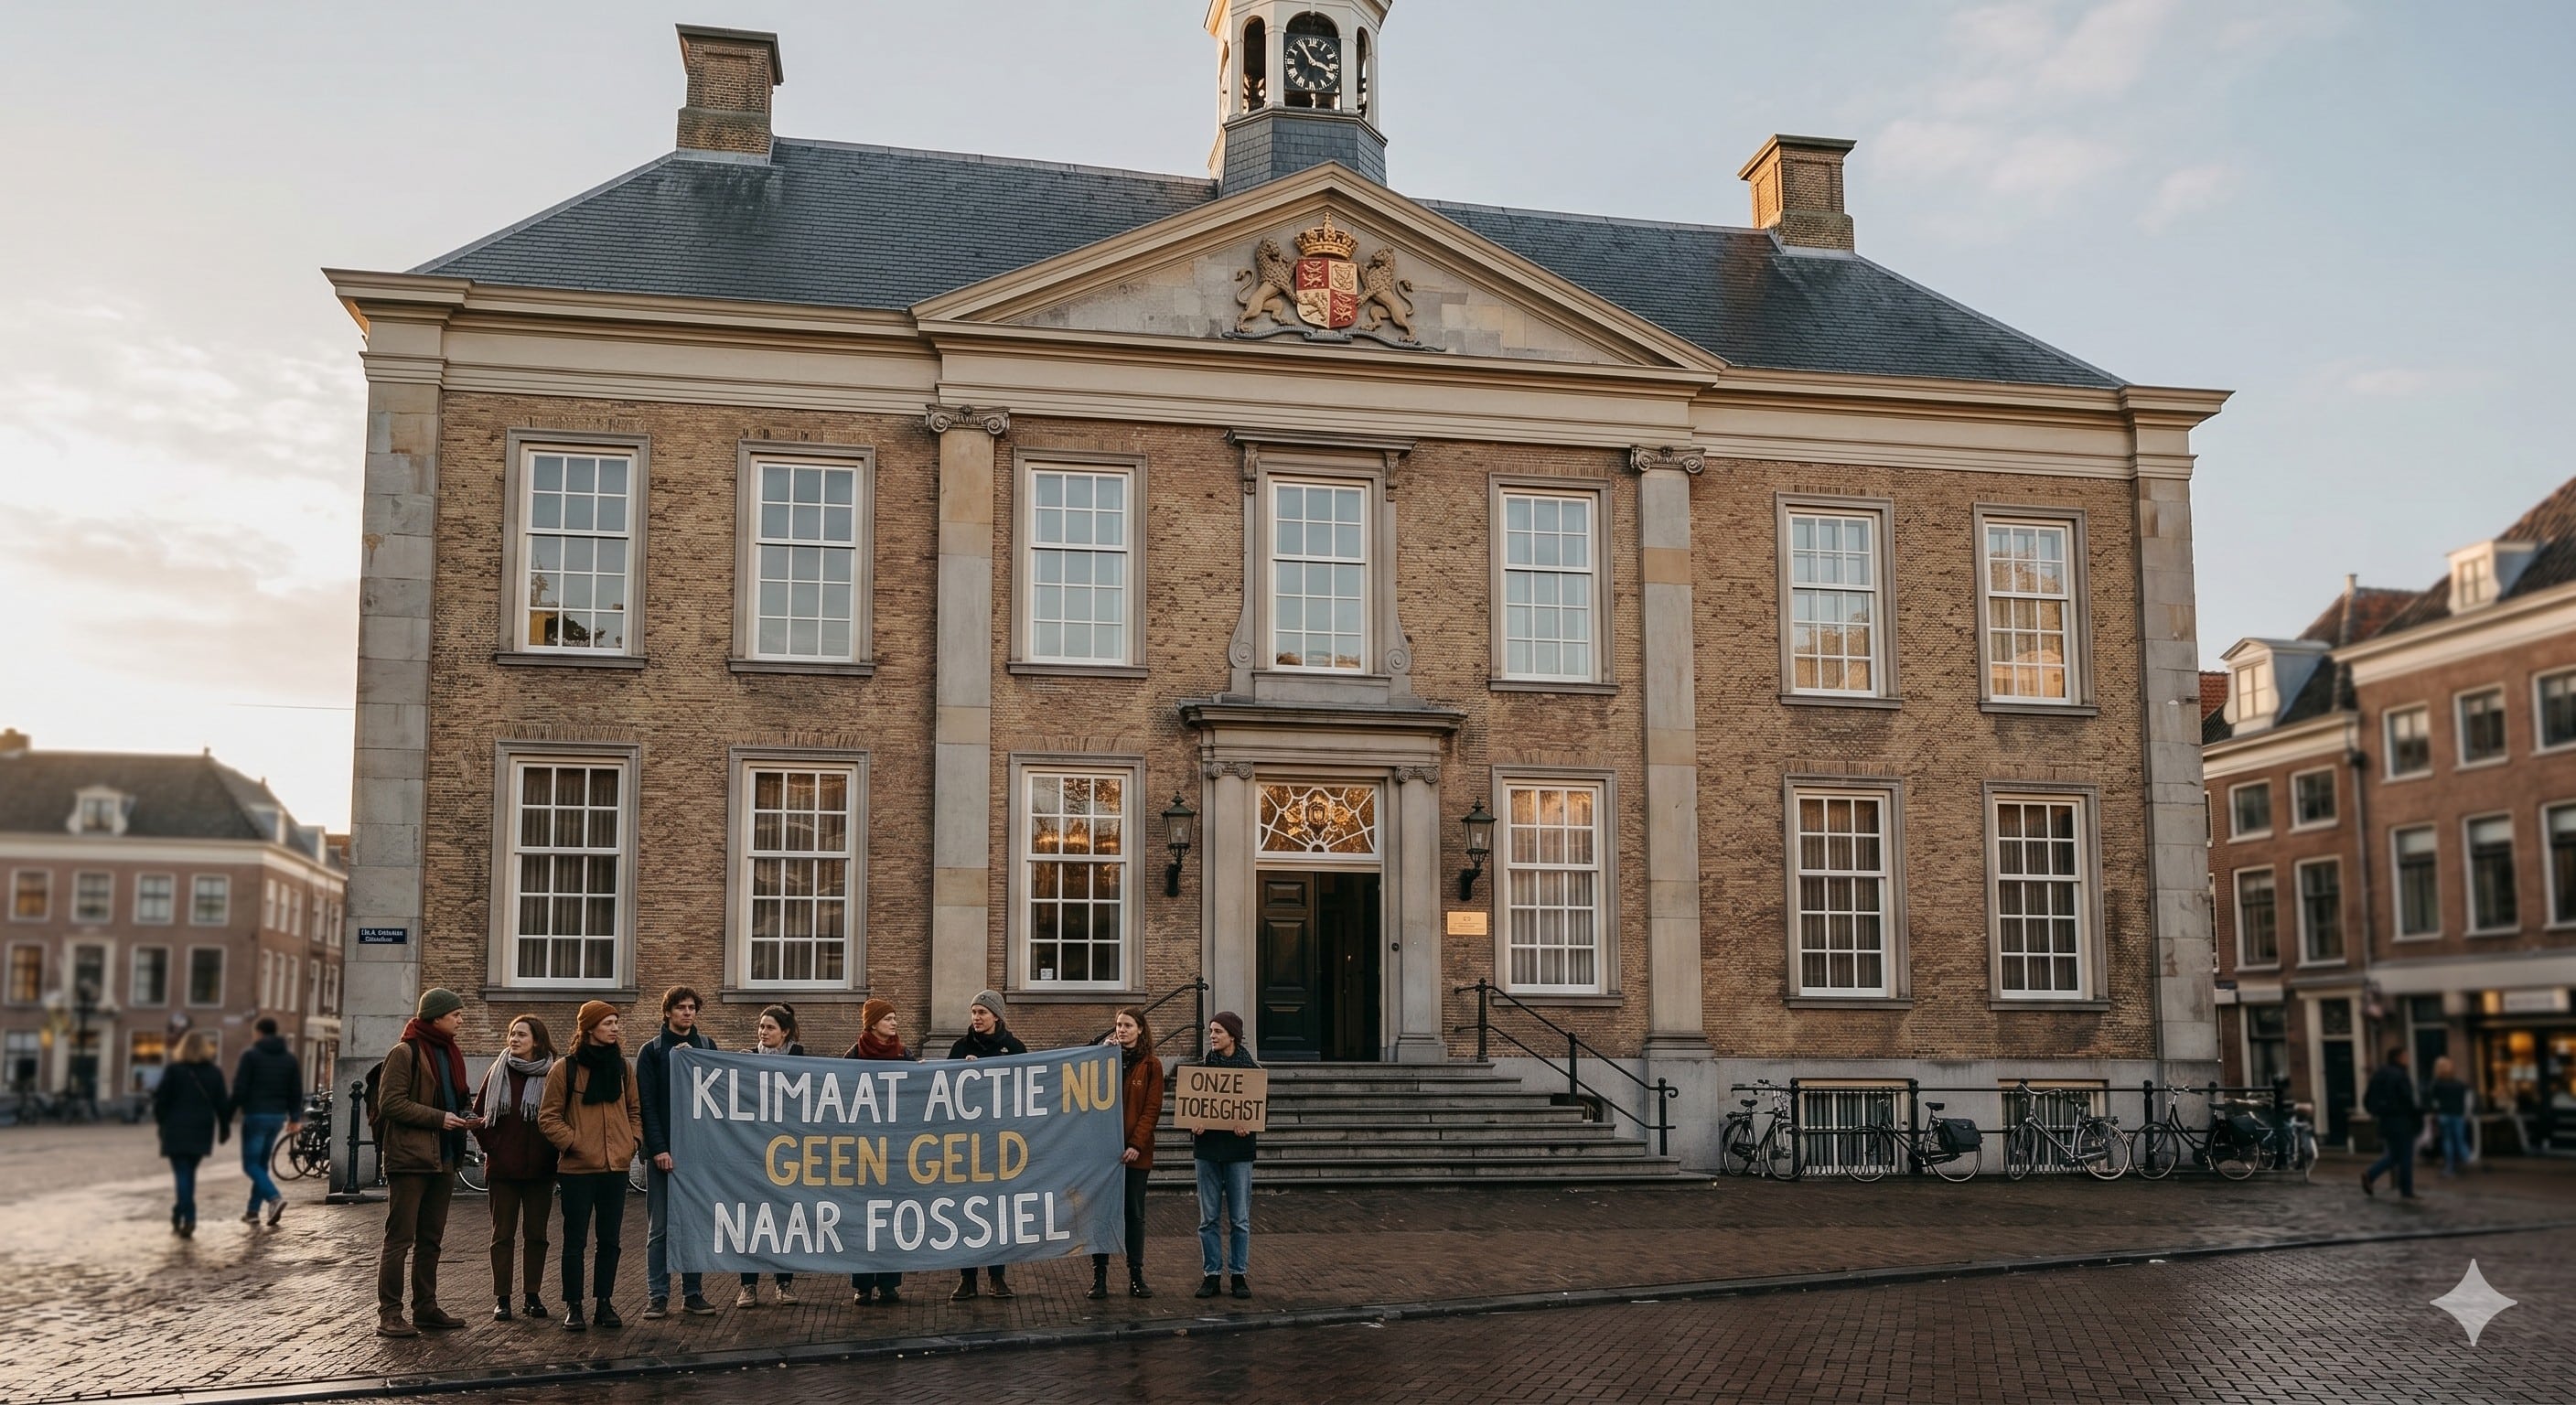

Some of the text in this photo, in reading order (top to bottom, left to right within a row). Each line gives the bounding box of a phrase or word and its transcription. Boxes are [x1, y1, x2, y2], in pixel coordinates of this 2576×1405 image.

[692, 1057, 1117, 1124] KLIMAAT ACTIE NU
[1190, 1072, 1244, 1095] ONZE
[766, 1131, 1029, 1187] GEEN GELD
[714, 1191, 1071, 1255] NAAR FOSSIEL
